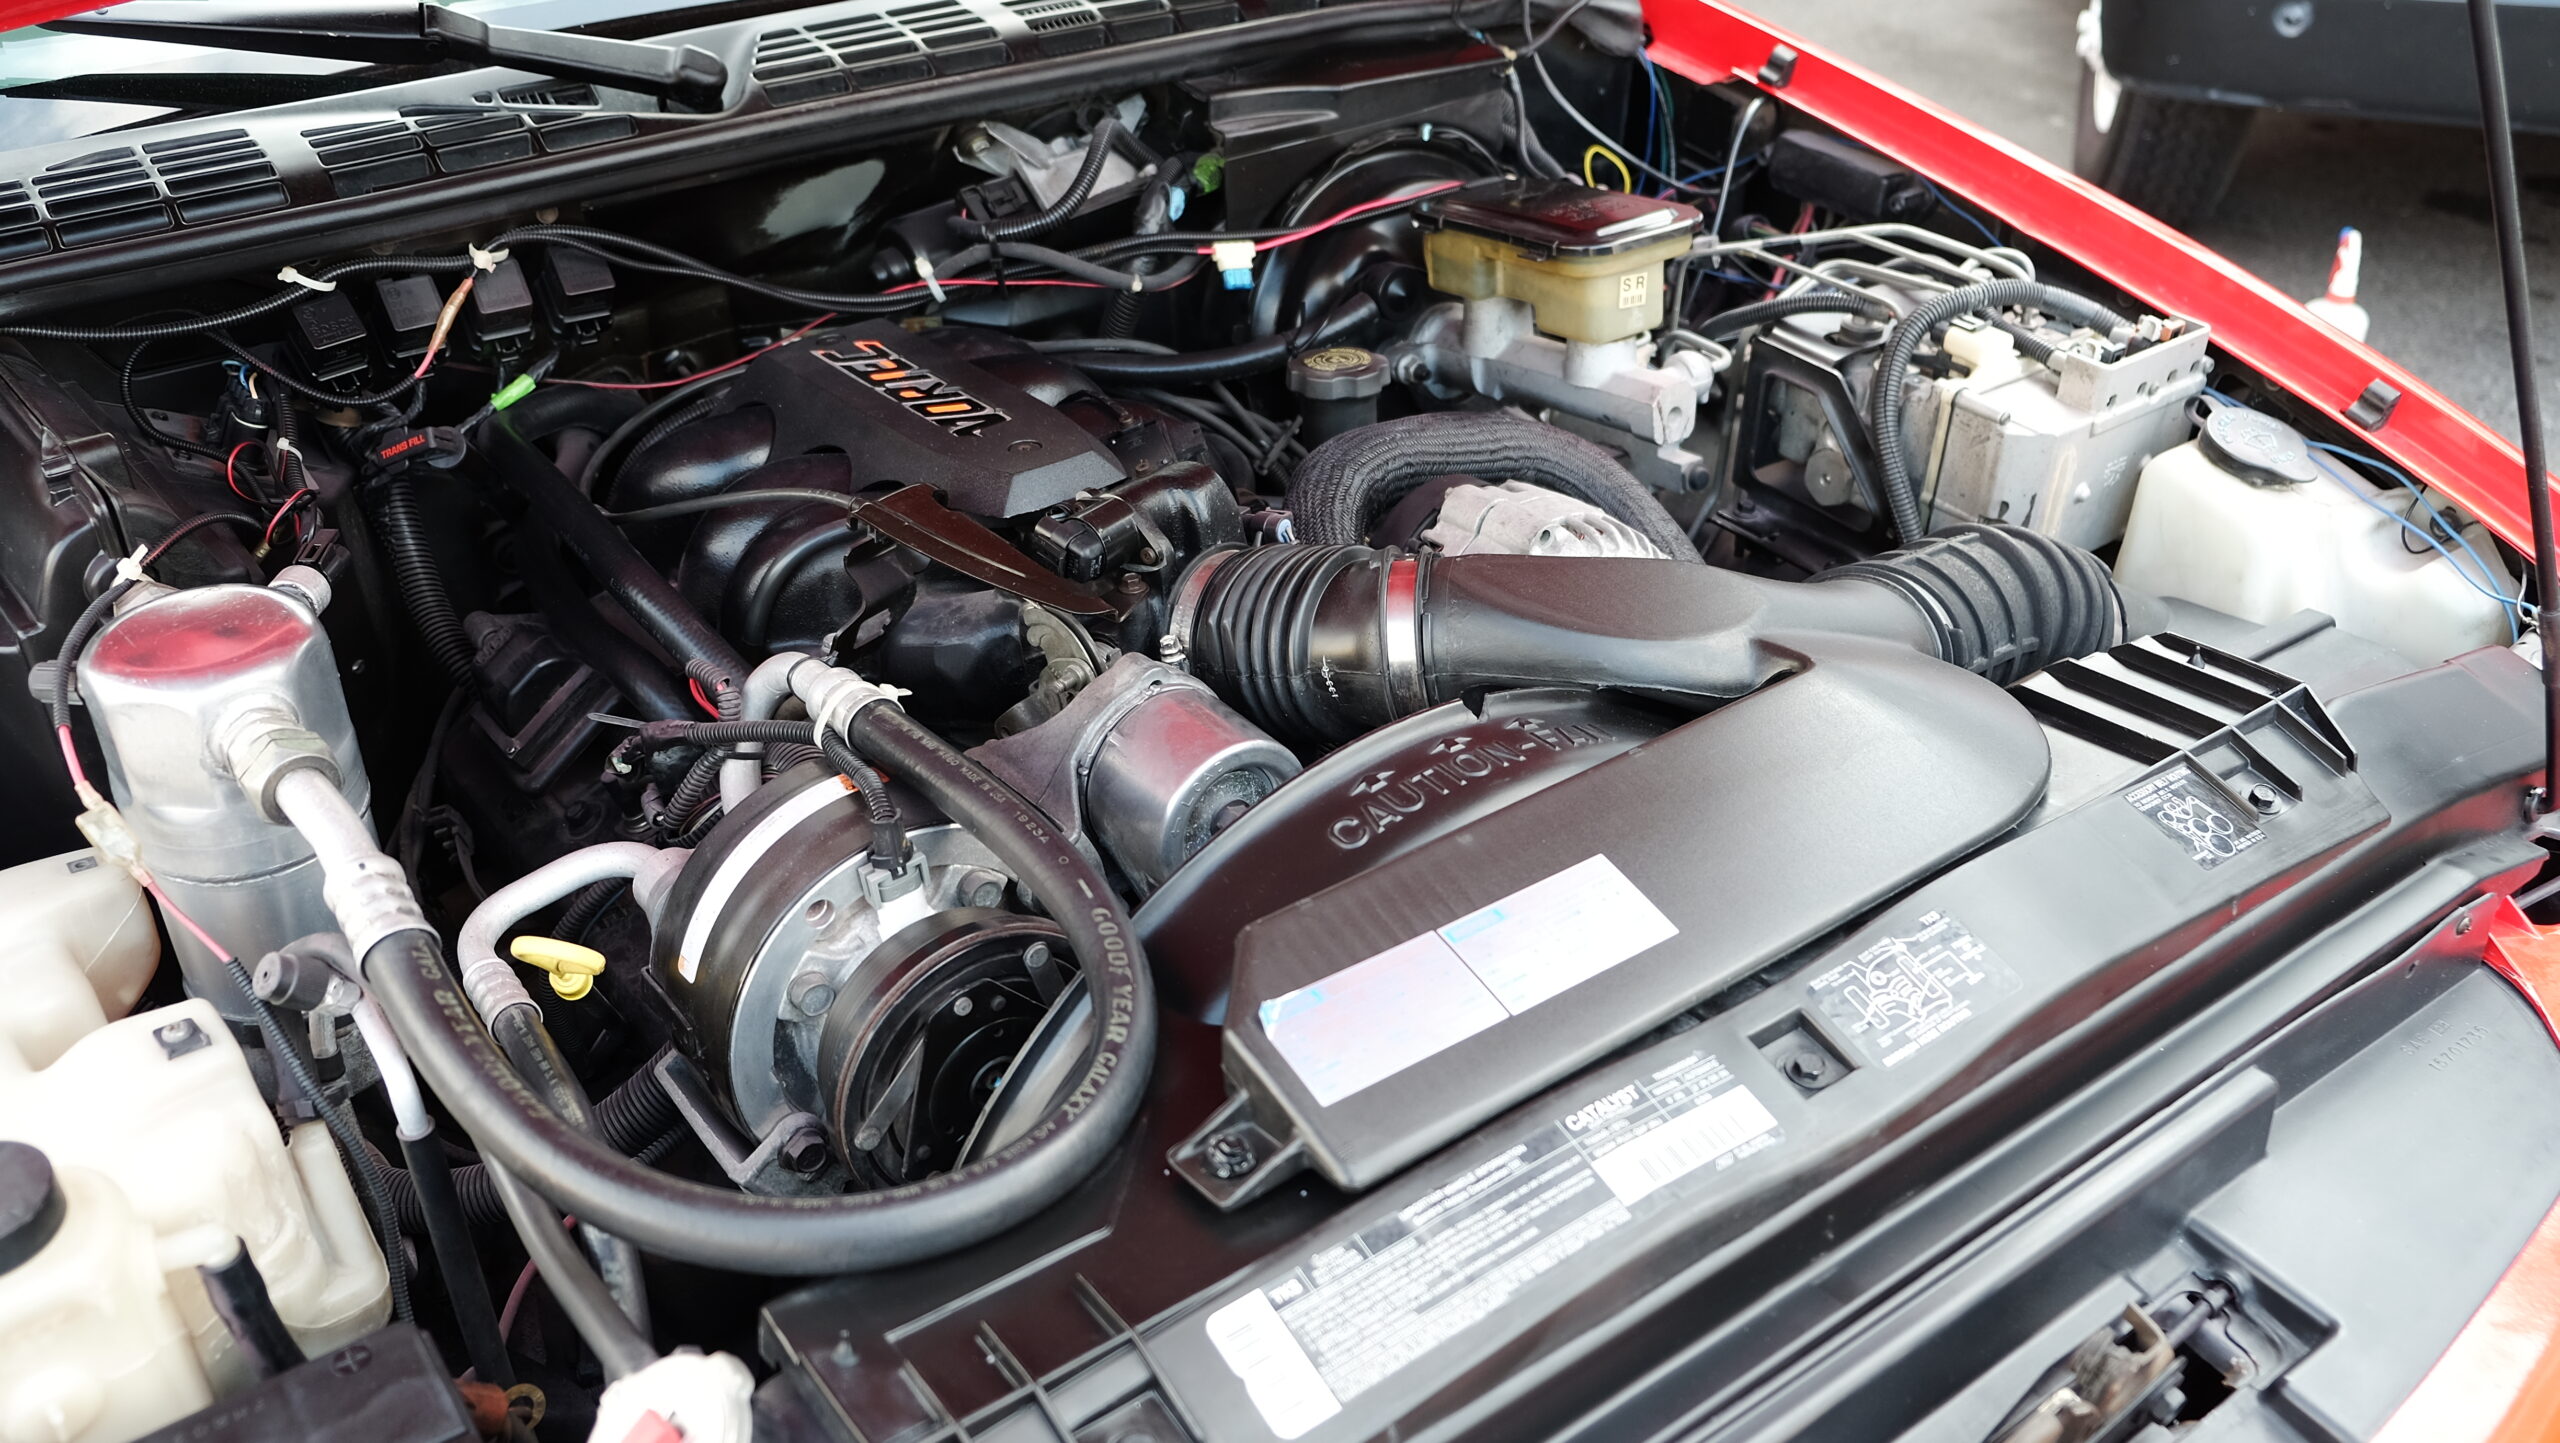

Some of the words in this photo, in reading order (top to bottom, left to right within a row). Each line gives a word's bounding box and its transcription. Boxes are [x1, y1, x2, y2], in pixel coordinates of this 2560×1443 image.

[380, 441, 409, 460] TRANS
[409, 434, 425, 448] FILL
[960, 767, 981, 784] MADE
[1062, 1051, 1118, 1122] GALAXY
[1565, 1084, 1640, 1132] CATALYST
